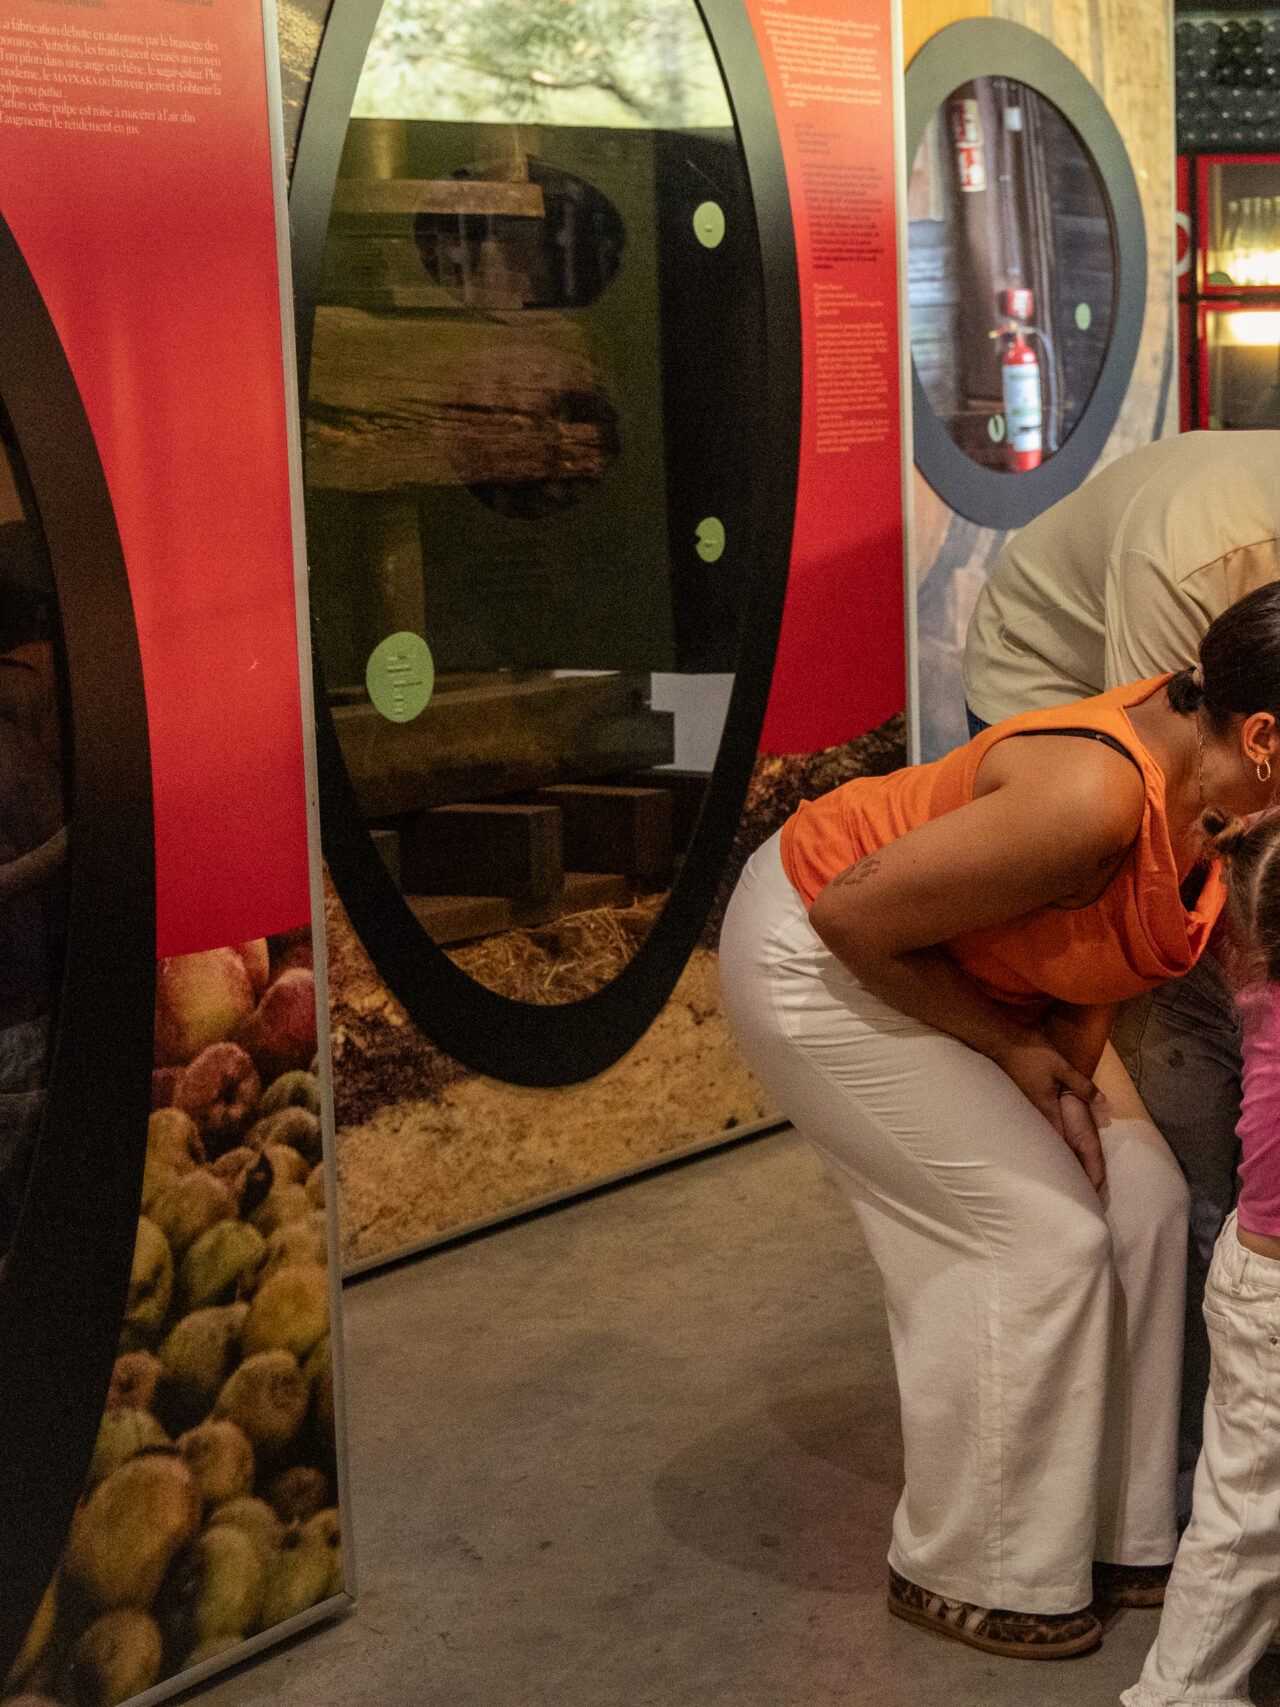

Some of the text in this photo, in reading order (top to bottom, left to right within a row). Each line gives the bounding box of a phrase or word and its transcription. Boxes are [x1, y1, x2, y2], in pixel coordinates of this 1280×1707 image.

[11, 18, 58, 33] fabrication
[61, 23, 91, 38] débute
[93, 31, 104, 40] en
[106, 31, 144, 44] automne
[145, 36, 159, 48] par
[160, 34, 167, 46] le
[204, 39, 217, 52] des
[84, 41, 96, 54] les
[98, 43, 119, 56] fruits
[44, 52, 63, 66] dans
[65, 59, 81, 68] une
[85, 61, 104, 74] auge
[42, 67, 50, 80] le
[53, 73, 97, 84] MATXAKA
[24, 86, 36, 94] ou
[52, 101, 76, 117] pulpe
[79, 105, 90, 115] est
